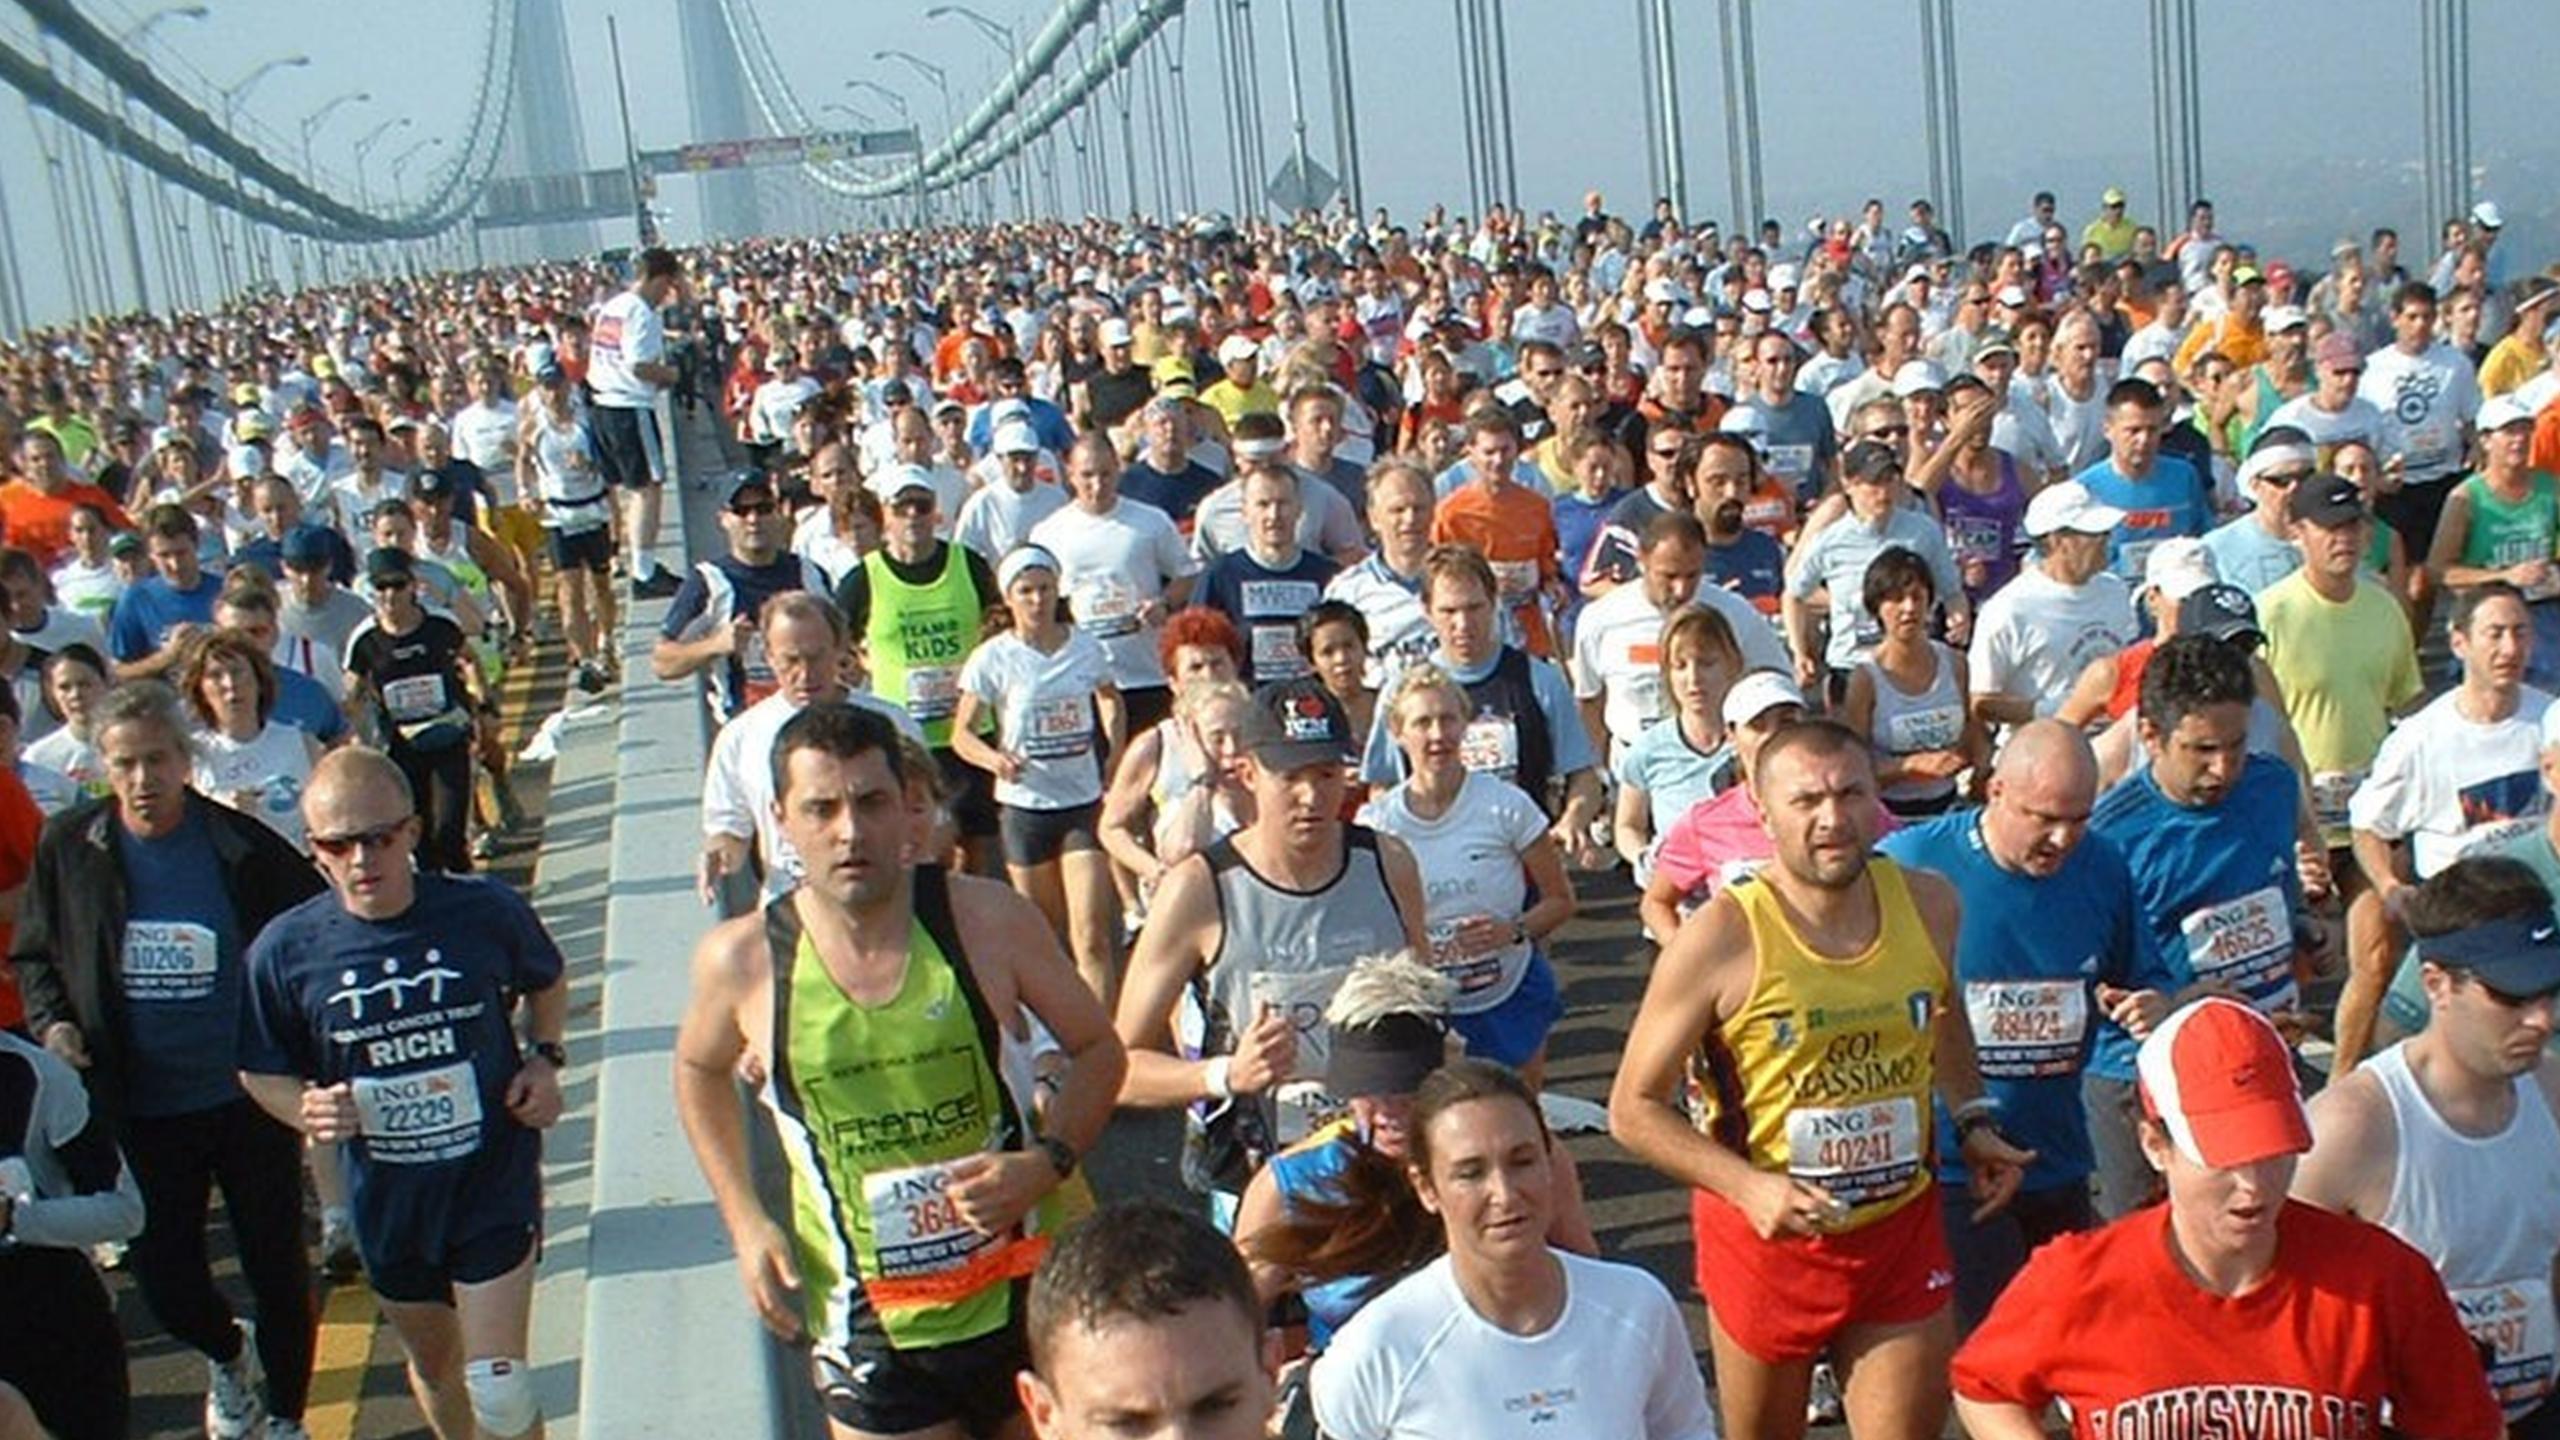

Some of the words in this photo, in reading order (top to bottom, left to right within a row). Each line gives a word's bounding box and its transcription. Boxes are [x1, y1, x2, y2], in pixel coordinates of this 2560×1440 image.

[130, 945, 195, 971] 10206
[1988, 989, 2035, 1008] ING
[367, 1026, 456, 1068] RICH
[1825, 1029, 1880, 1065] GO!
[372, 1080, 422, 1101] ING
[380, 1096, 456, 1133] 22329
[832, 1092, 979, 1145] FRANCE
[1811, 1113, 1864, 1137] ING
[1818, 1132, 1894, 1169] 40241
[904, 1195, 958, 1239] 364
[2456, 1294, 2497, 1317] NG
